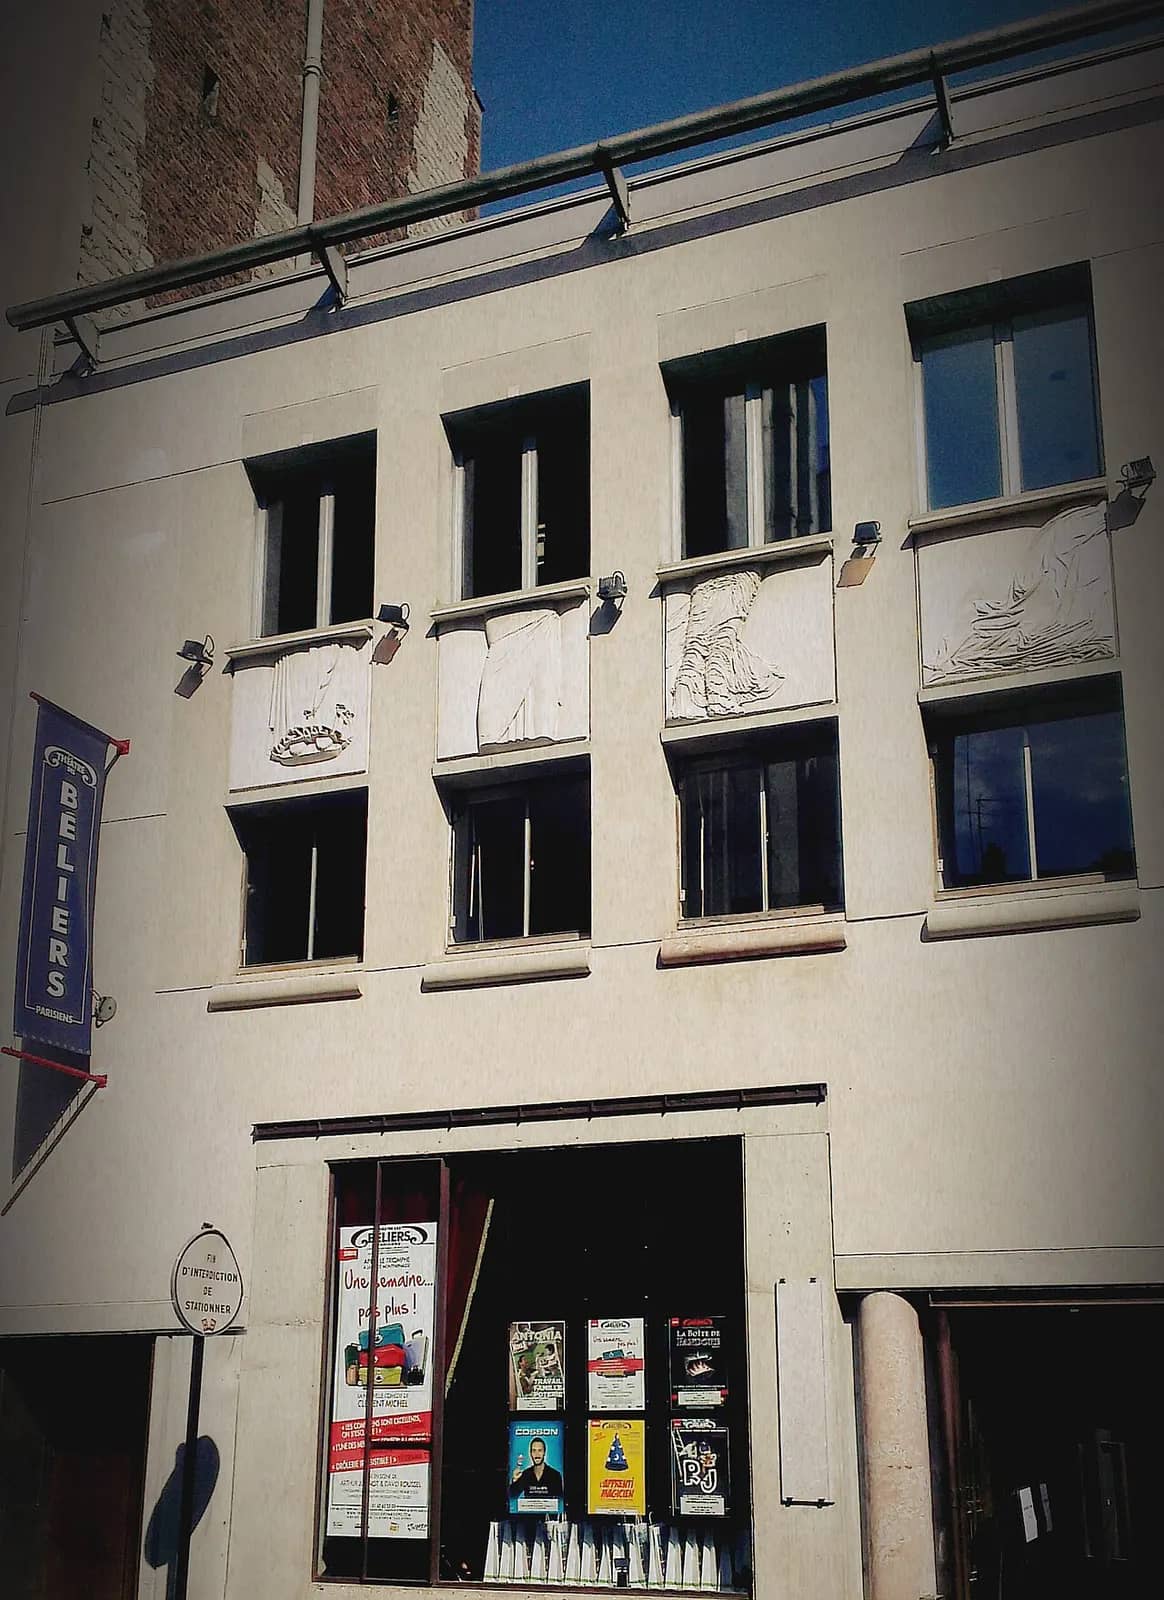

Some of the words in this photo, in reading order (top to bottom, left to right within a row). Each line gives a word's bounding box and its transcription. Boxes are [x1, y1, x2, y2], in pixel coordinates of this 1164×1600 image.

[35, 1004, 74, 1024] PARISIENS
[182, 1266, 238, 1283] D'INTERDICTION
[344, 1268, 370, 1290] Une
[203, 1286, 213, 1297] DE
[185, 1300, 232, 1315] STATIONNER
[385, 1296, 410, 1324] plus
[511, 1329, 563, 1342] ANTONIA
[515, 1428, 559, 1436] COSSON
